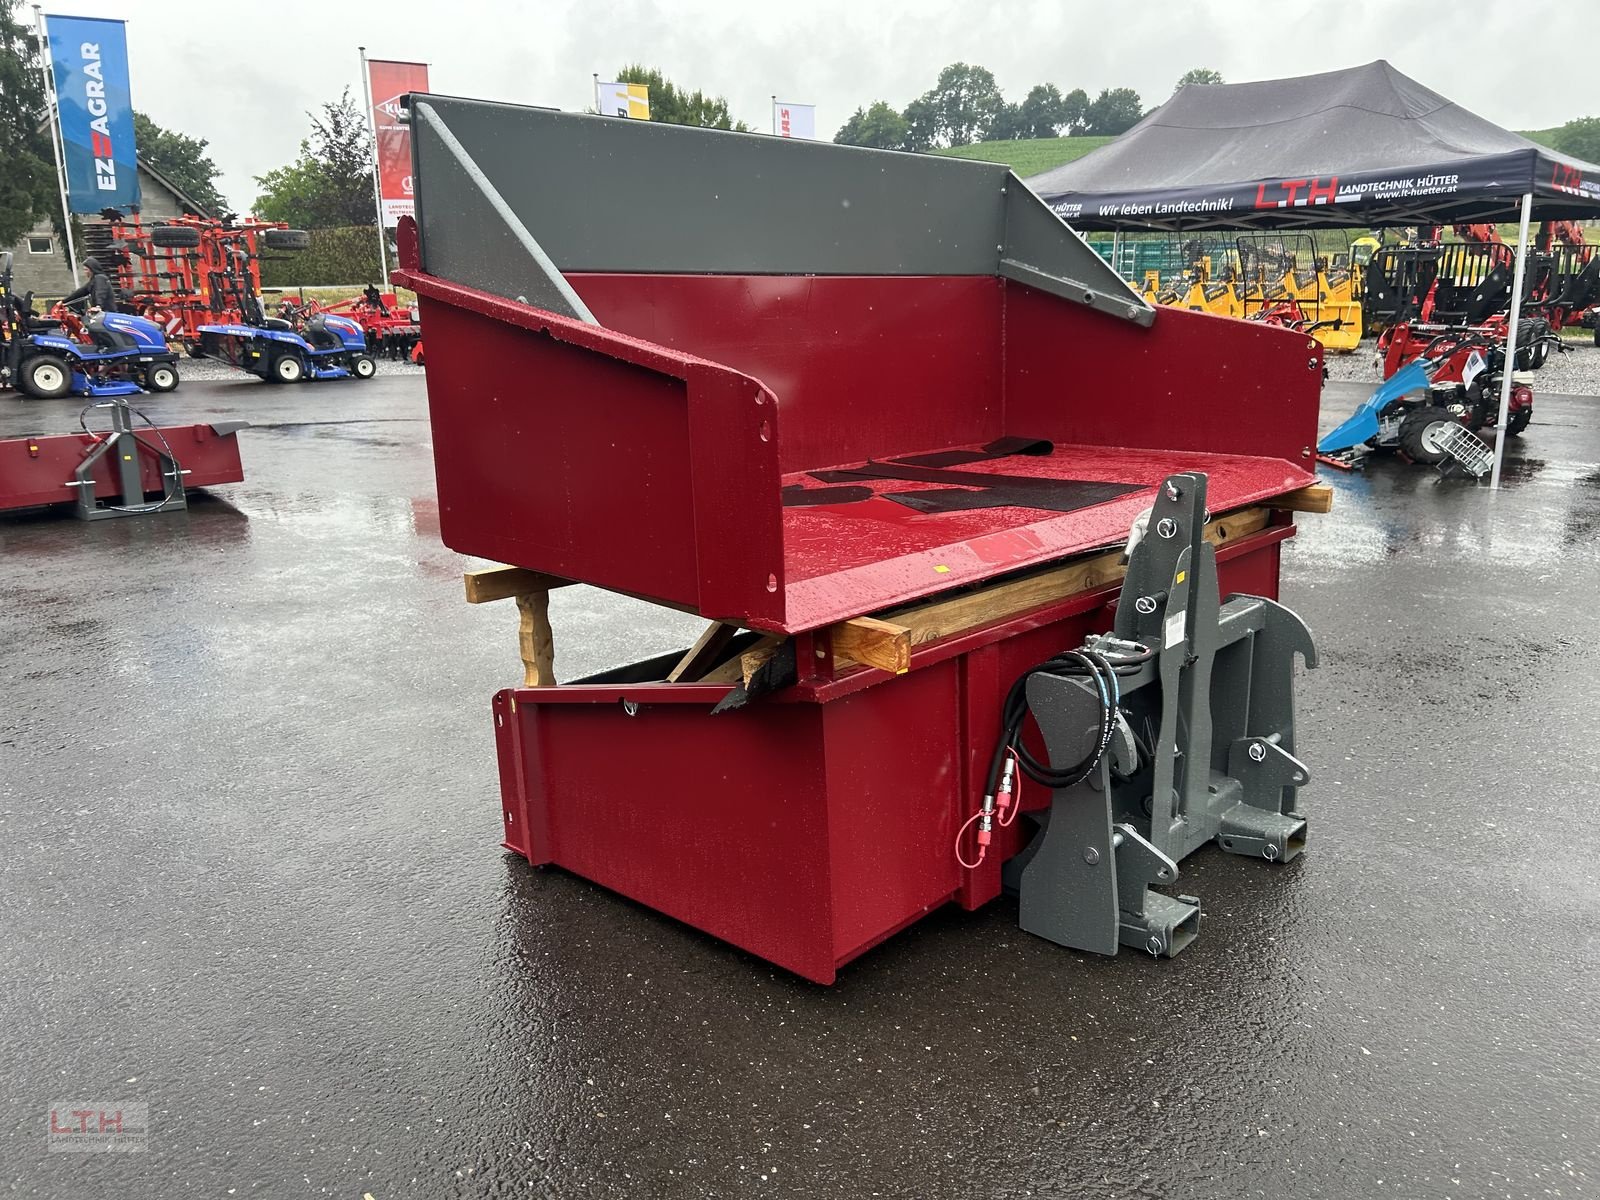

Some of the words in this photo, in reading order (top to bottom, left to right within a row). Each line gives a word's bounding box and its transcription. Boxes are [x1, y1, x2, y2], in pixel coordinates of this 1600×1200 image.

[81, 42, 110, 137] AGRAR
[95, 158, 117, 191] EZ
[1551, 161, 1582, 192] LTH
[1099, 204, 1118, 216] Wir
[1120, 202, 1152, 215] leben
[1155, 197, 1234, 214] Landtechnik!
[1255, 177, 1338, 208] LTH
[1339, 178, 1414, 195] LANDTECHNIK
[1416, 174, 1459, 188] HÜTTER
[1375, 185, 1458, 200] www.lt-huetter.at
[1055, 202, 1083, 212] HÜTTER
